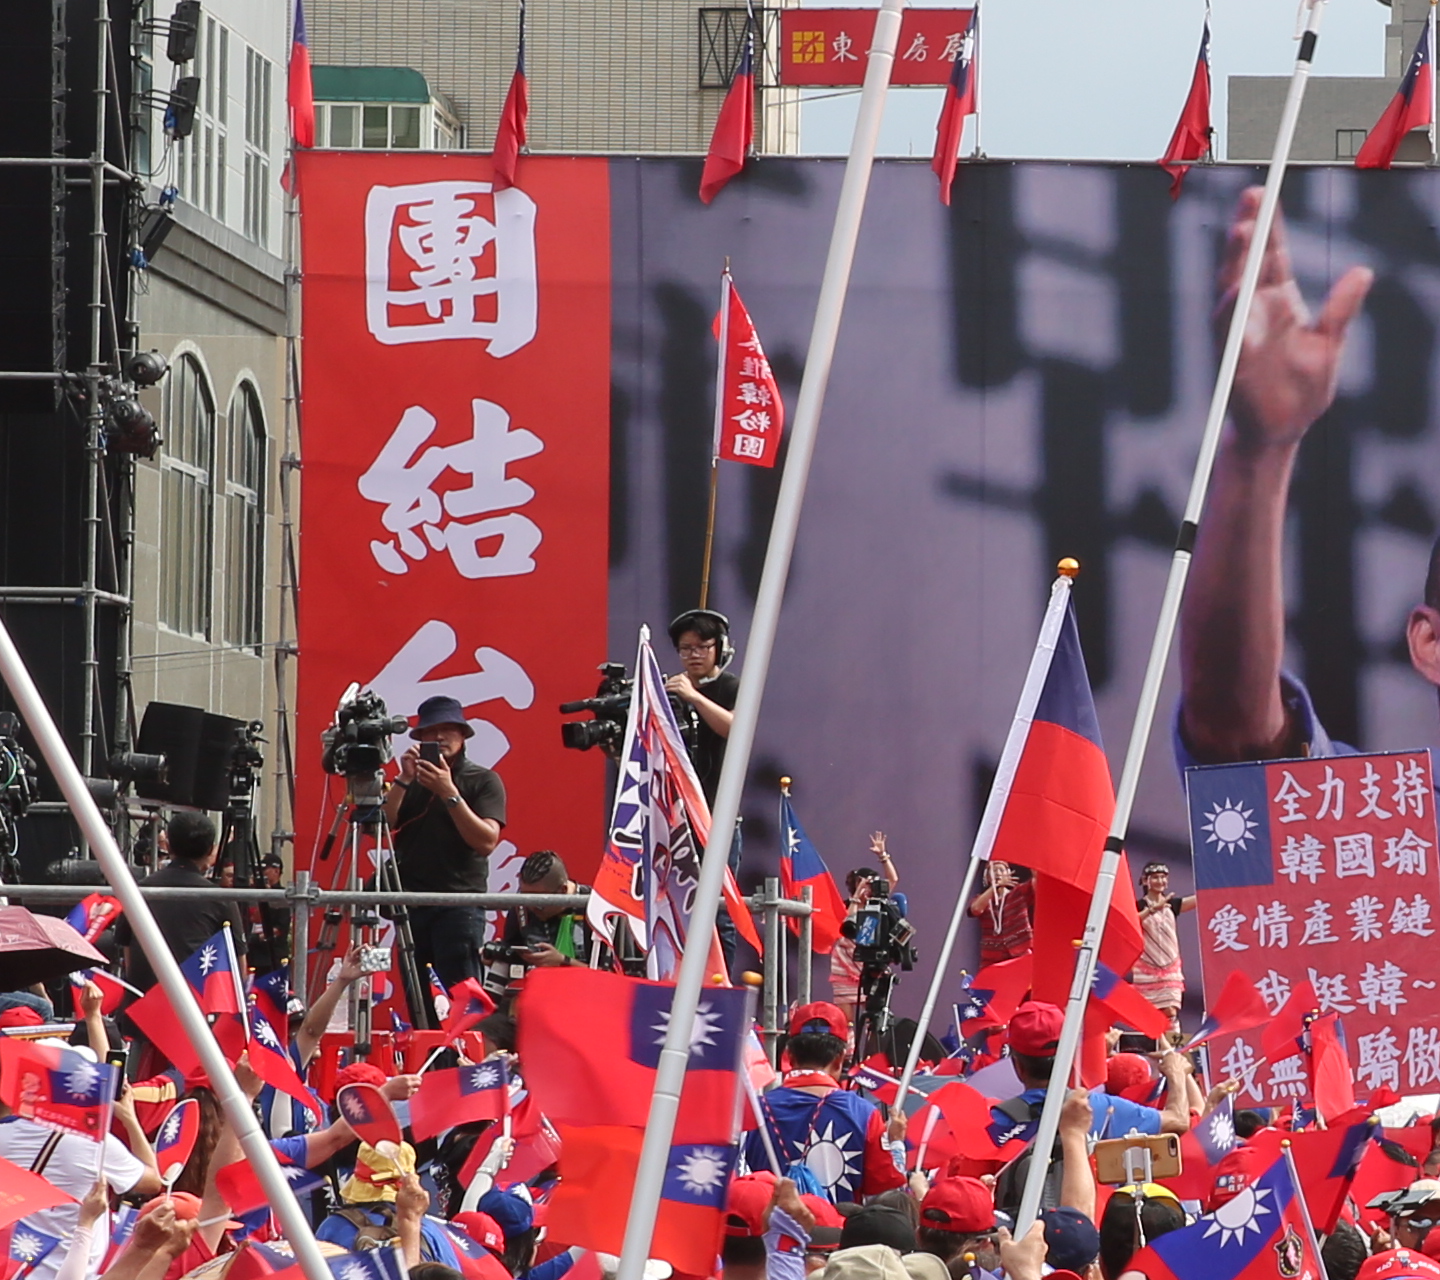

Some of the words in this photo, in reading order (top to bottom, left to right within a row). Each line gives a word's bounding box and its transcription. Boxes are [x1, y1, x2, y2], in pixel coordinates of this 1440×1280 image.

[1273, 758, 1427, 824] 全力支持
[1279, 828, 1434, 884] 韓國瑜
[1208, 893, 1435, 953] 愛情產業鏈
